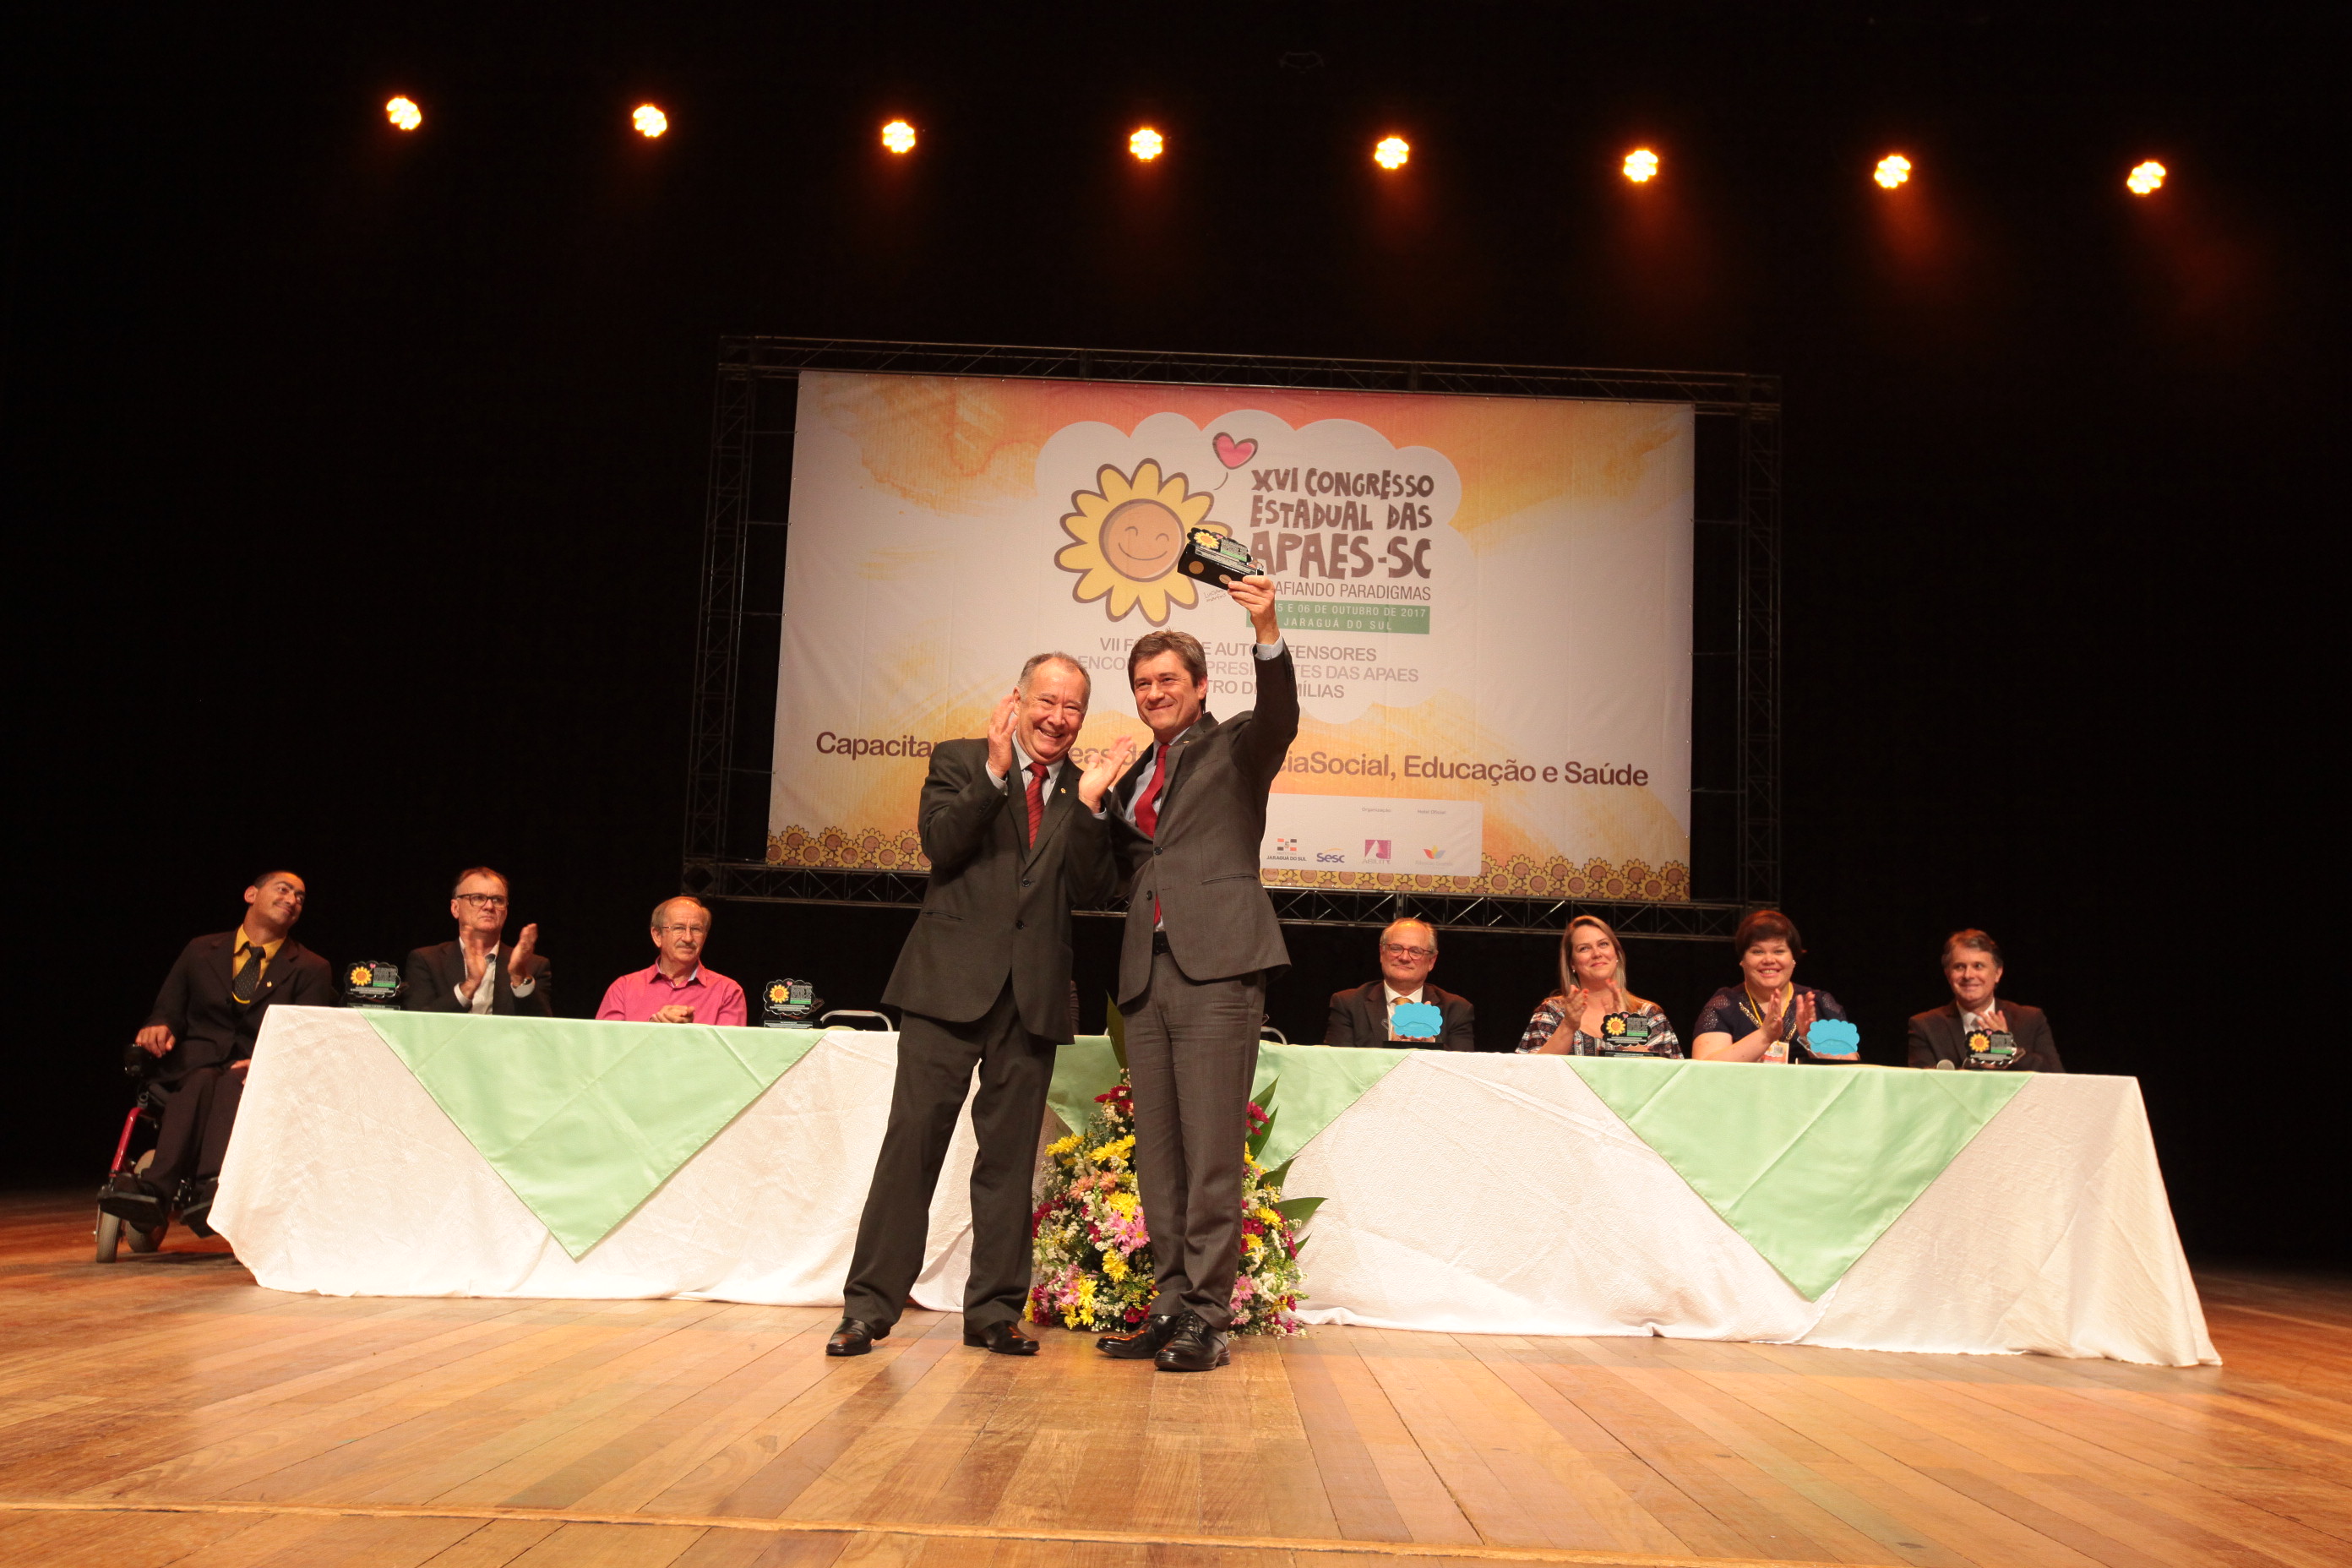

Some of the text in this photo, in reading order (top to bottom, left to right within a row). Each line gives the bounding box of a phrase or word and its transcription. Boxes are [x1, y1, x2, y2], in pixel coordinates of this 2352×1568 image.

[1251, 467, 1435, 499] XVI CONGRESSO
[1250, 495, 1433, 531] ESTADUAL DAS
[1250, 531, 1432, 580] APAES-SC
[1276, 581, 1431, 601] AFIANDO PARADIGMAS
[1275, 603, 1426, 618] 5 E 06 DE OUTUBRO DE 2017
[1284, 618, 1392, 630] JARAGUÁ DO SUL
[1100, 637, 1120, 651] VII
[1077, 656, 1128, 671] ENCO
[1326, 665, 1360, 680] DAS
[1364, 667, 1419, 683] APAES
[1297, 680, 1345, 699] MÍLIAS
[816, 731, 937, 761] Capacita
[1280, 750, 1396, 781] iaSocial,
[1404, 755, 1537, 787] Educação
[1542, 765, 1559, 783] e
[1565, 760, 1649, 787] Saúde
[1316, 852, 1345, 863] Sesc
